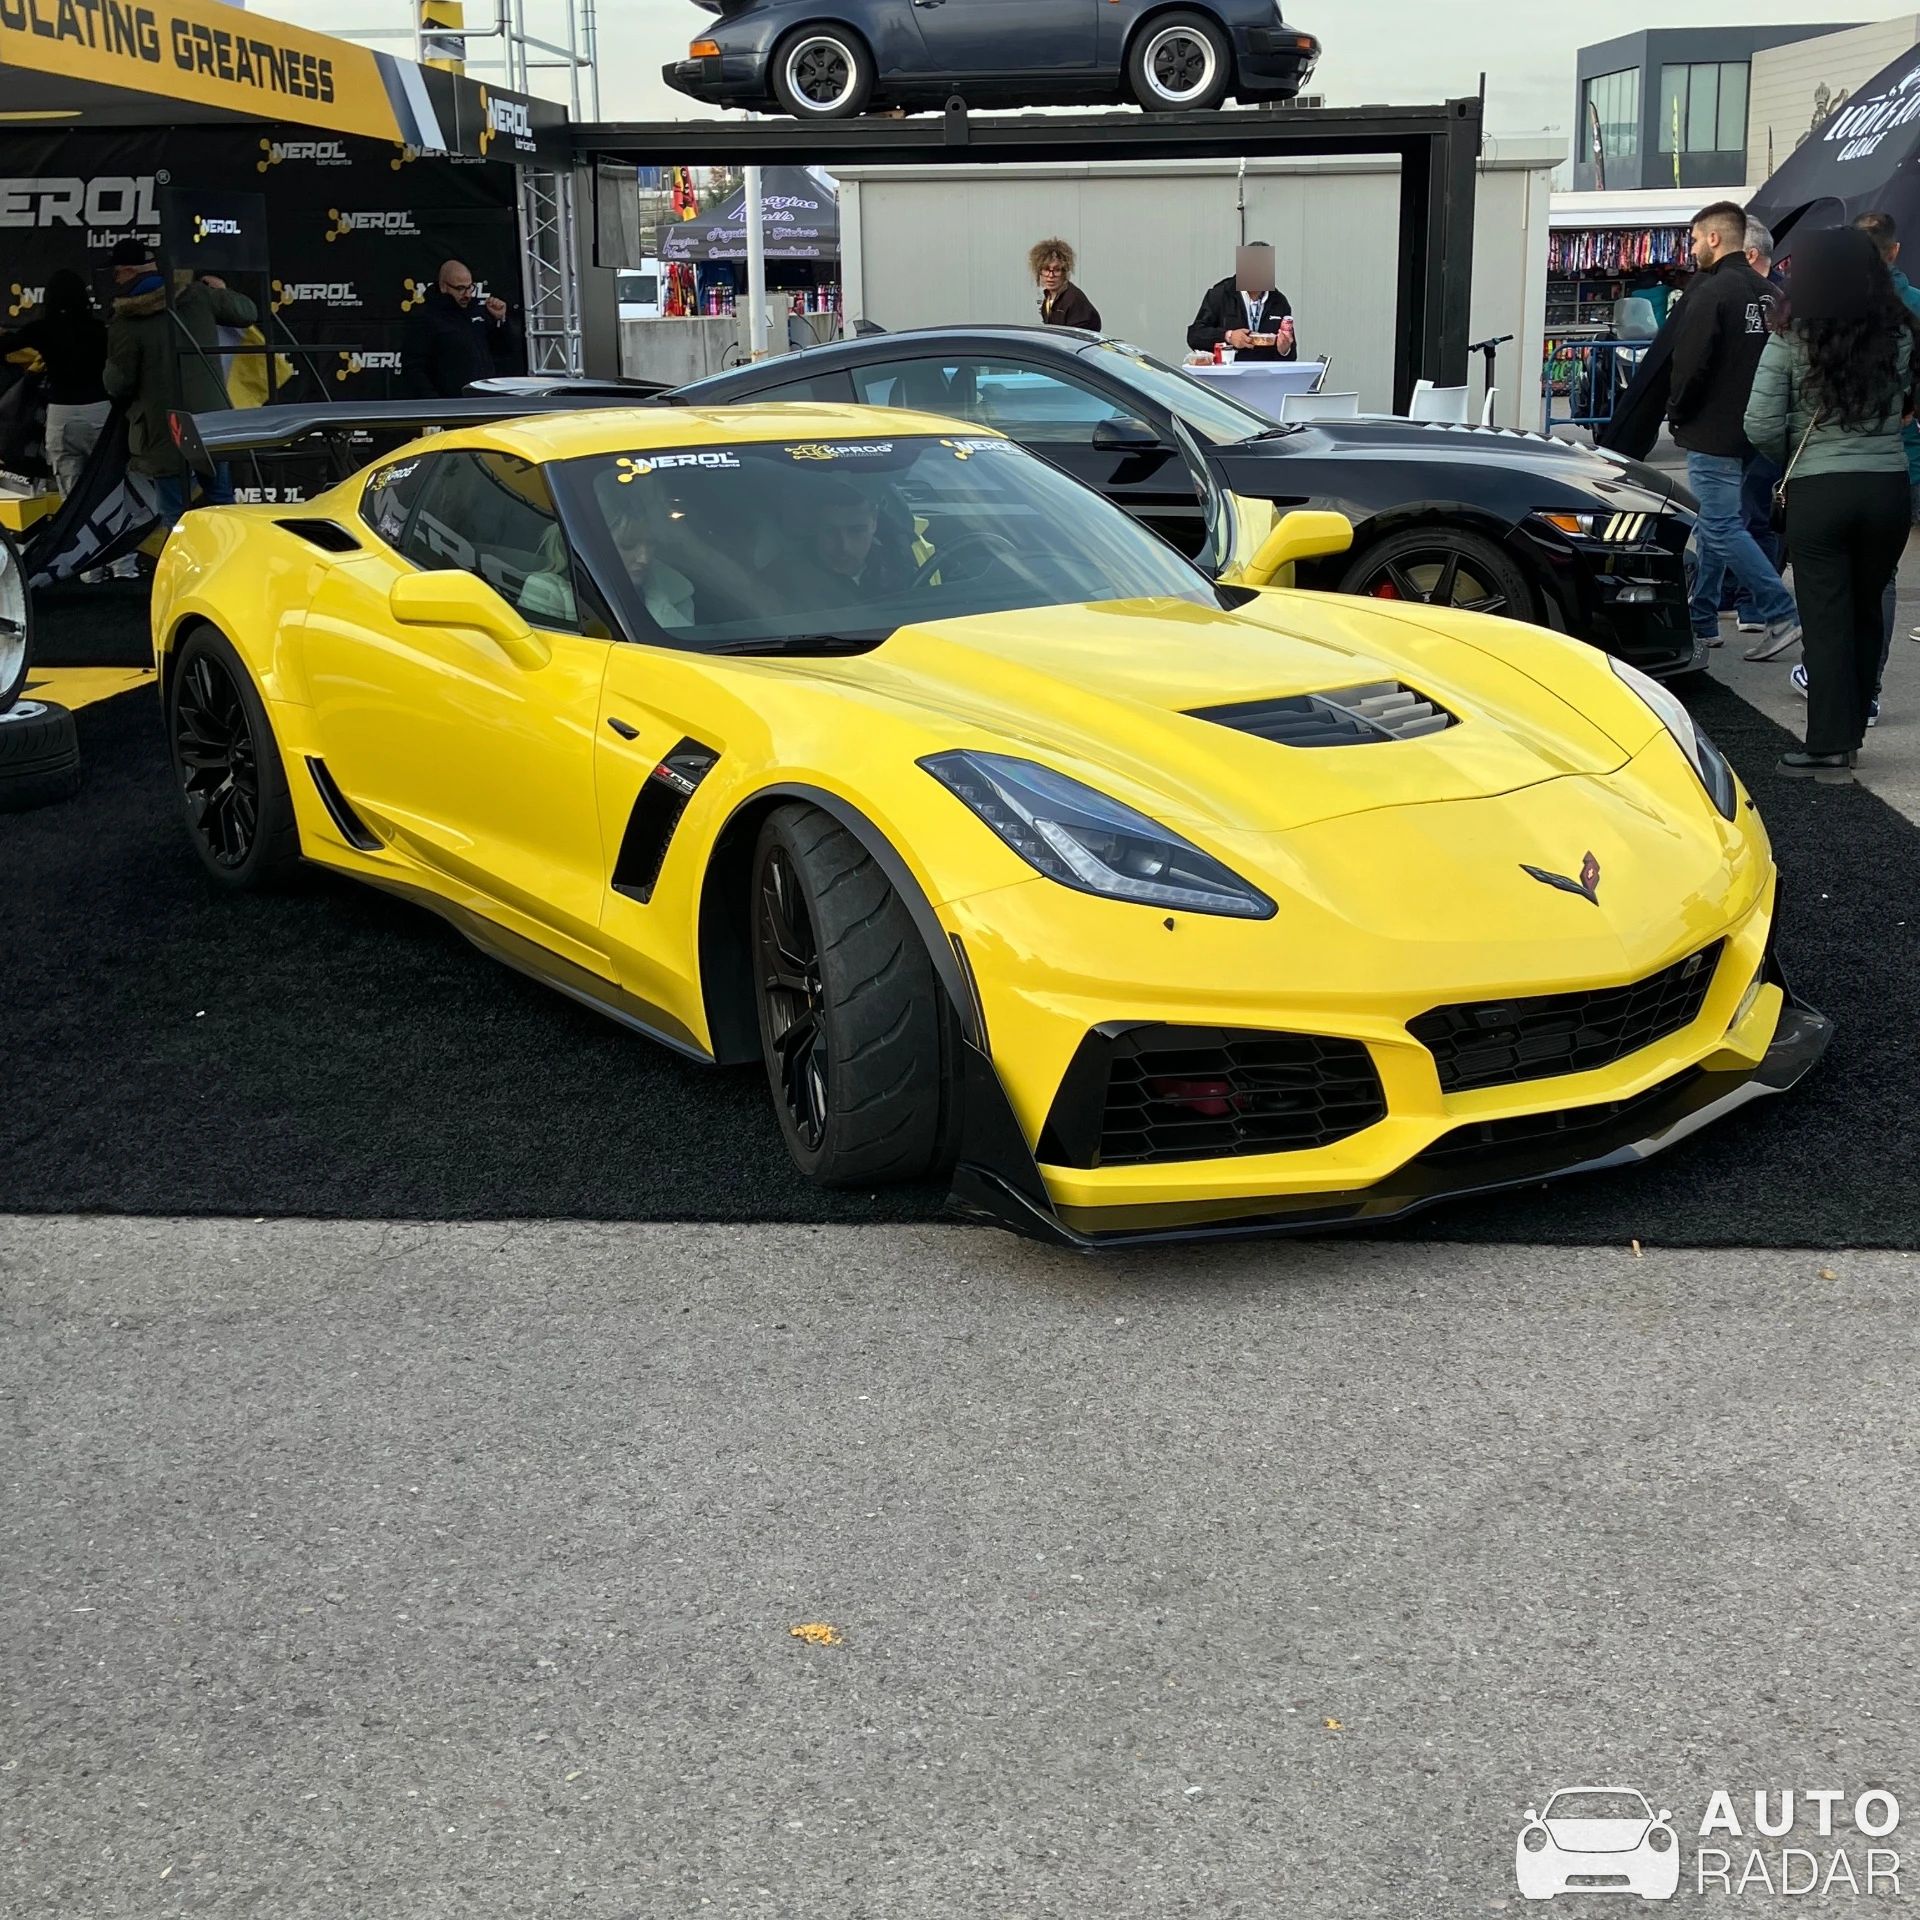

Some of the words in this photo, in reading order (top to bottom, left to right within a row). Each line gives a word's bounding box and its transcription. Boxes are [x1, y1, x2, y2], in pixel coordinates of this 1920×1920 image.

[170, 17, 334, 104] GREATNESS
[488, 96, 532, 138] NEROL
[272, 142, 347, 159] NEROL
[316, 158, 352, 166] lubricants
[201, 219, 241, 234] NEROL
[341, 211, 415, 229] NEROL
[384, 228, 421, 236] lubricants
[772, 227, 819, 240] Stickers
[284, 283, 358, 300] NEROL
[327, 299, 363, 307] lubricants
[954, 440, 1022, 454] NEROL
[635, 453, 740, 470] NEROL
